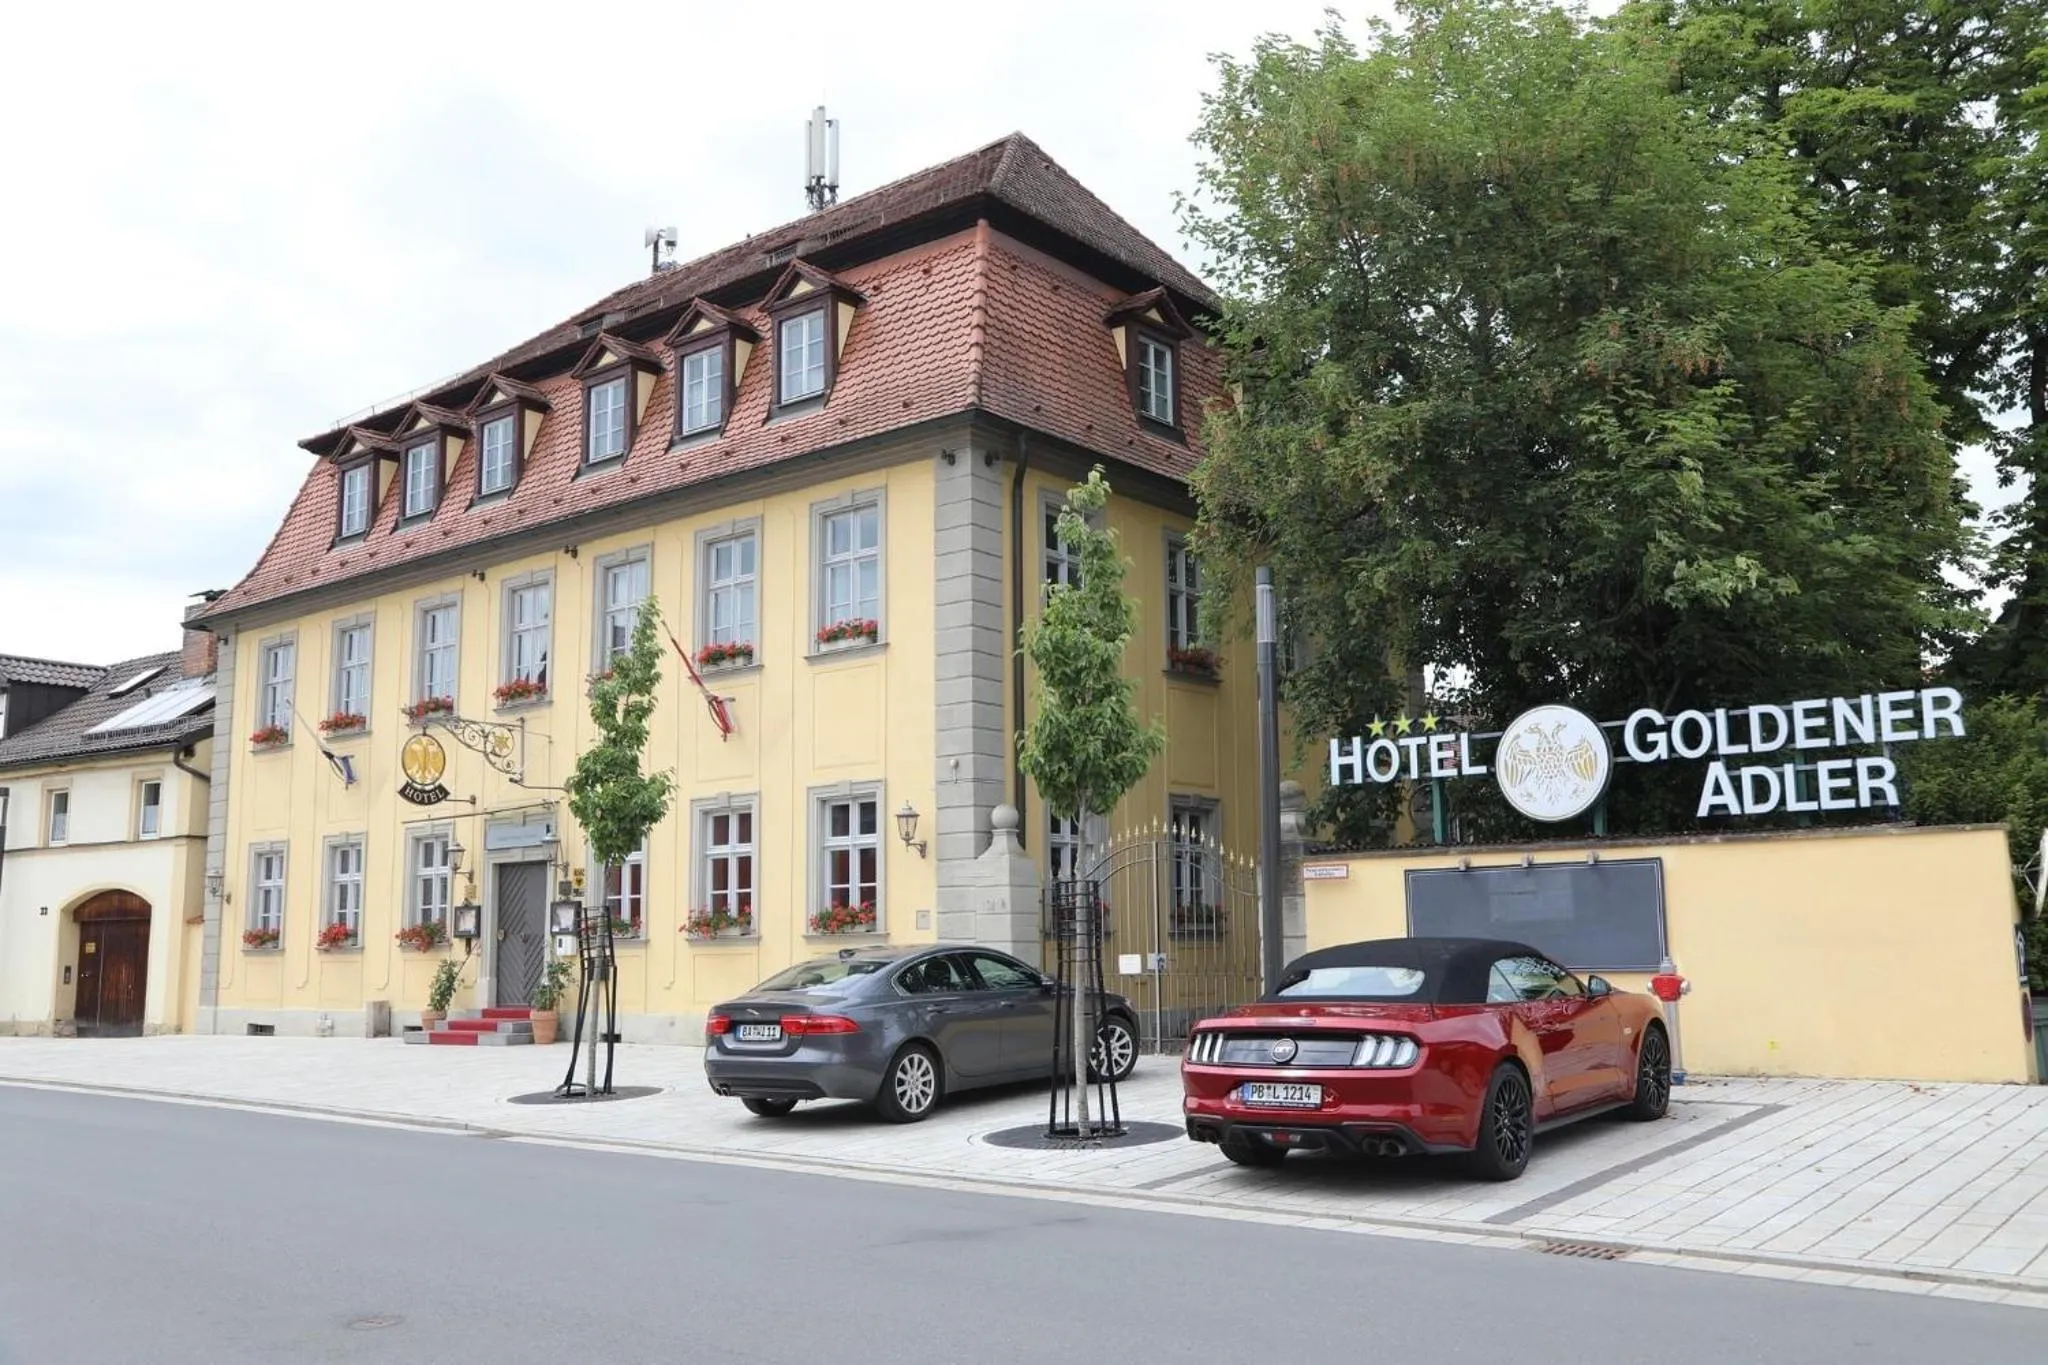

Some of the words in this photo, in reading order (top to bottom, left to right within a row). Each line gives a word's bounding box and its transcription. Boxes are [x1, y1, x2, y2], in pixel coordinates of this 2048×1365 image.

[1624, 687, 1966, 763] GOLDENER
[1328, 732, 1488, 786] HOTEL
[404, 787, 444, 803] HOTEL
[1696, 756, 1900, 818] ADLER
[1251, 1084, 1265, 1099] PB
[1273, 1085, 1280, 1099] L
[1283, 1086, 1311, 1101] 1214
